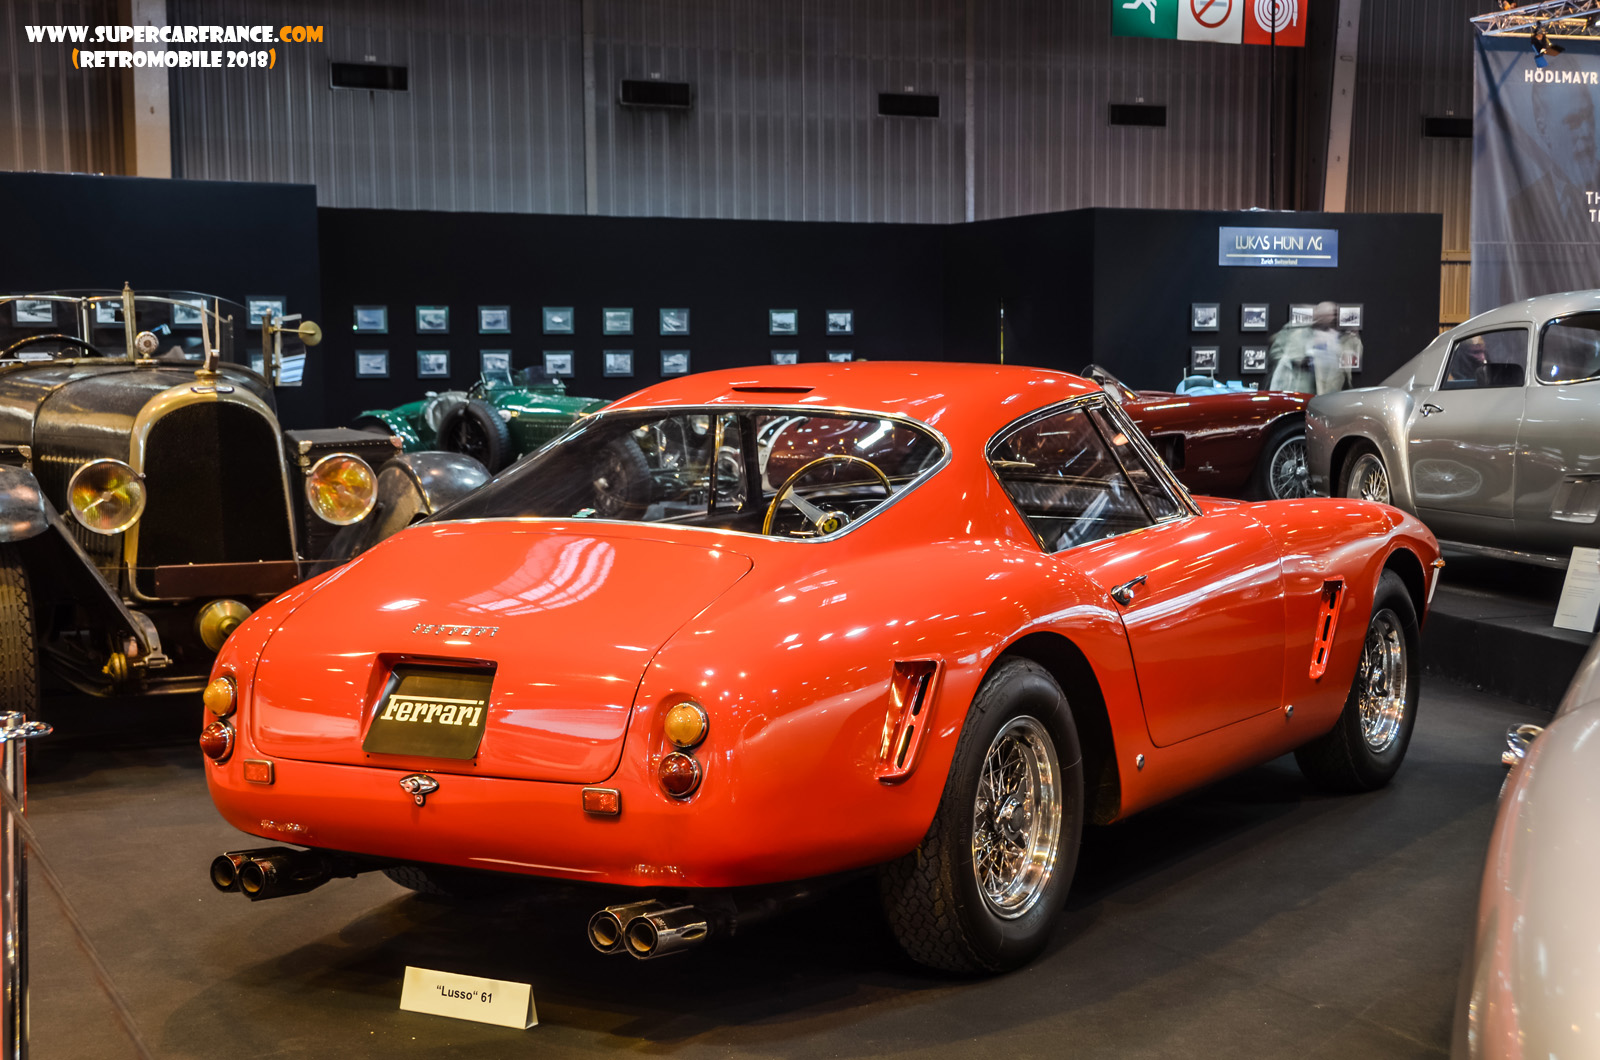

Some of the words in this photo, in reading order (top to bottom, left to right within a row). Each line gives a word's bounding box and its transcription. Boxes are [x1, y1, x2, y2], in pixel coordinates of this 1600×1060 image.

[1524, 67, 1599, 85] HÖDLMAYR
[1235, 235, 1270, 250] LUKAS
[1306, 235, 1323, 251] AG
[380, 694, 485, 727] Ferrari
[480, 992, 493, 1003] 61
